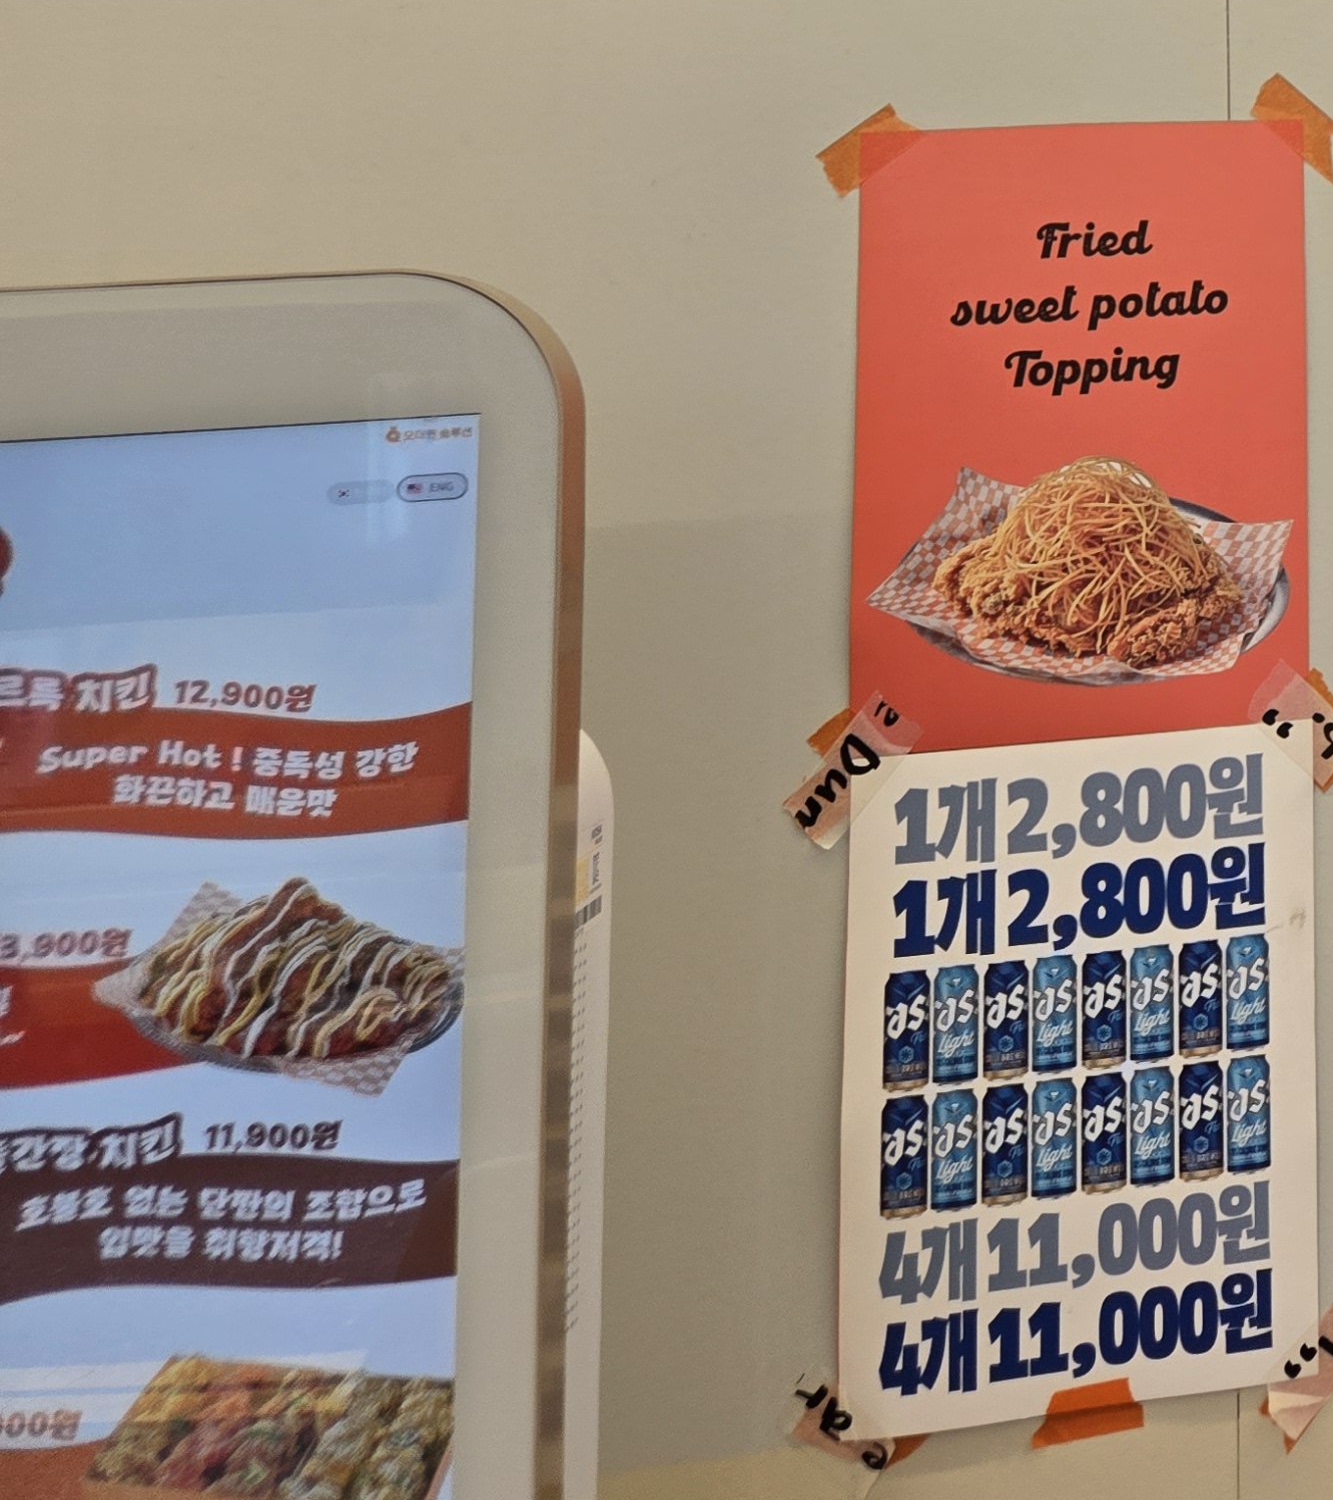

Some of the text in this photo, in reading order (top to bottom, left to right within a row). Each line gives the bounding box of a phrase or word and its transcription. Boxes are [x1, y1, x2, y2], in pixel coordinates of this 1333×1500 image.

[1035, 219, 1154, 259] Fried
[949, 279, 1229, 331] sweet potato
[1003, 345, 1180, 396] Topping
[73, 670, 152, 714] 치킨
[174, 678, 317, 714] 12,900원
[36, 743, 148, 774] Super
[157, 739, 224, 769] Hot
[893, 753, 1264, 866] 1개 2,800원
[892, 842, 1267, 959] 1개 2,800원
[0, 1119, 344, 1175] 간장 치킨 11,900원
[878, 1179, 1271, 1306] 4개 11,000원
[878, 1307, 980, 1396] 4개
[987, 1268, 1273, 1379] 11,000원
[0, 1408, 84, 1441] 00원
